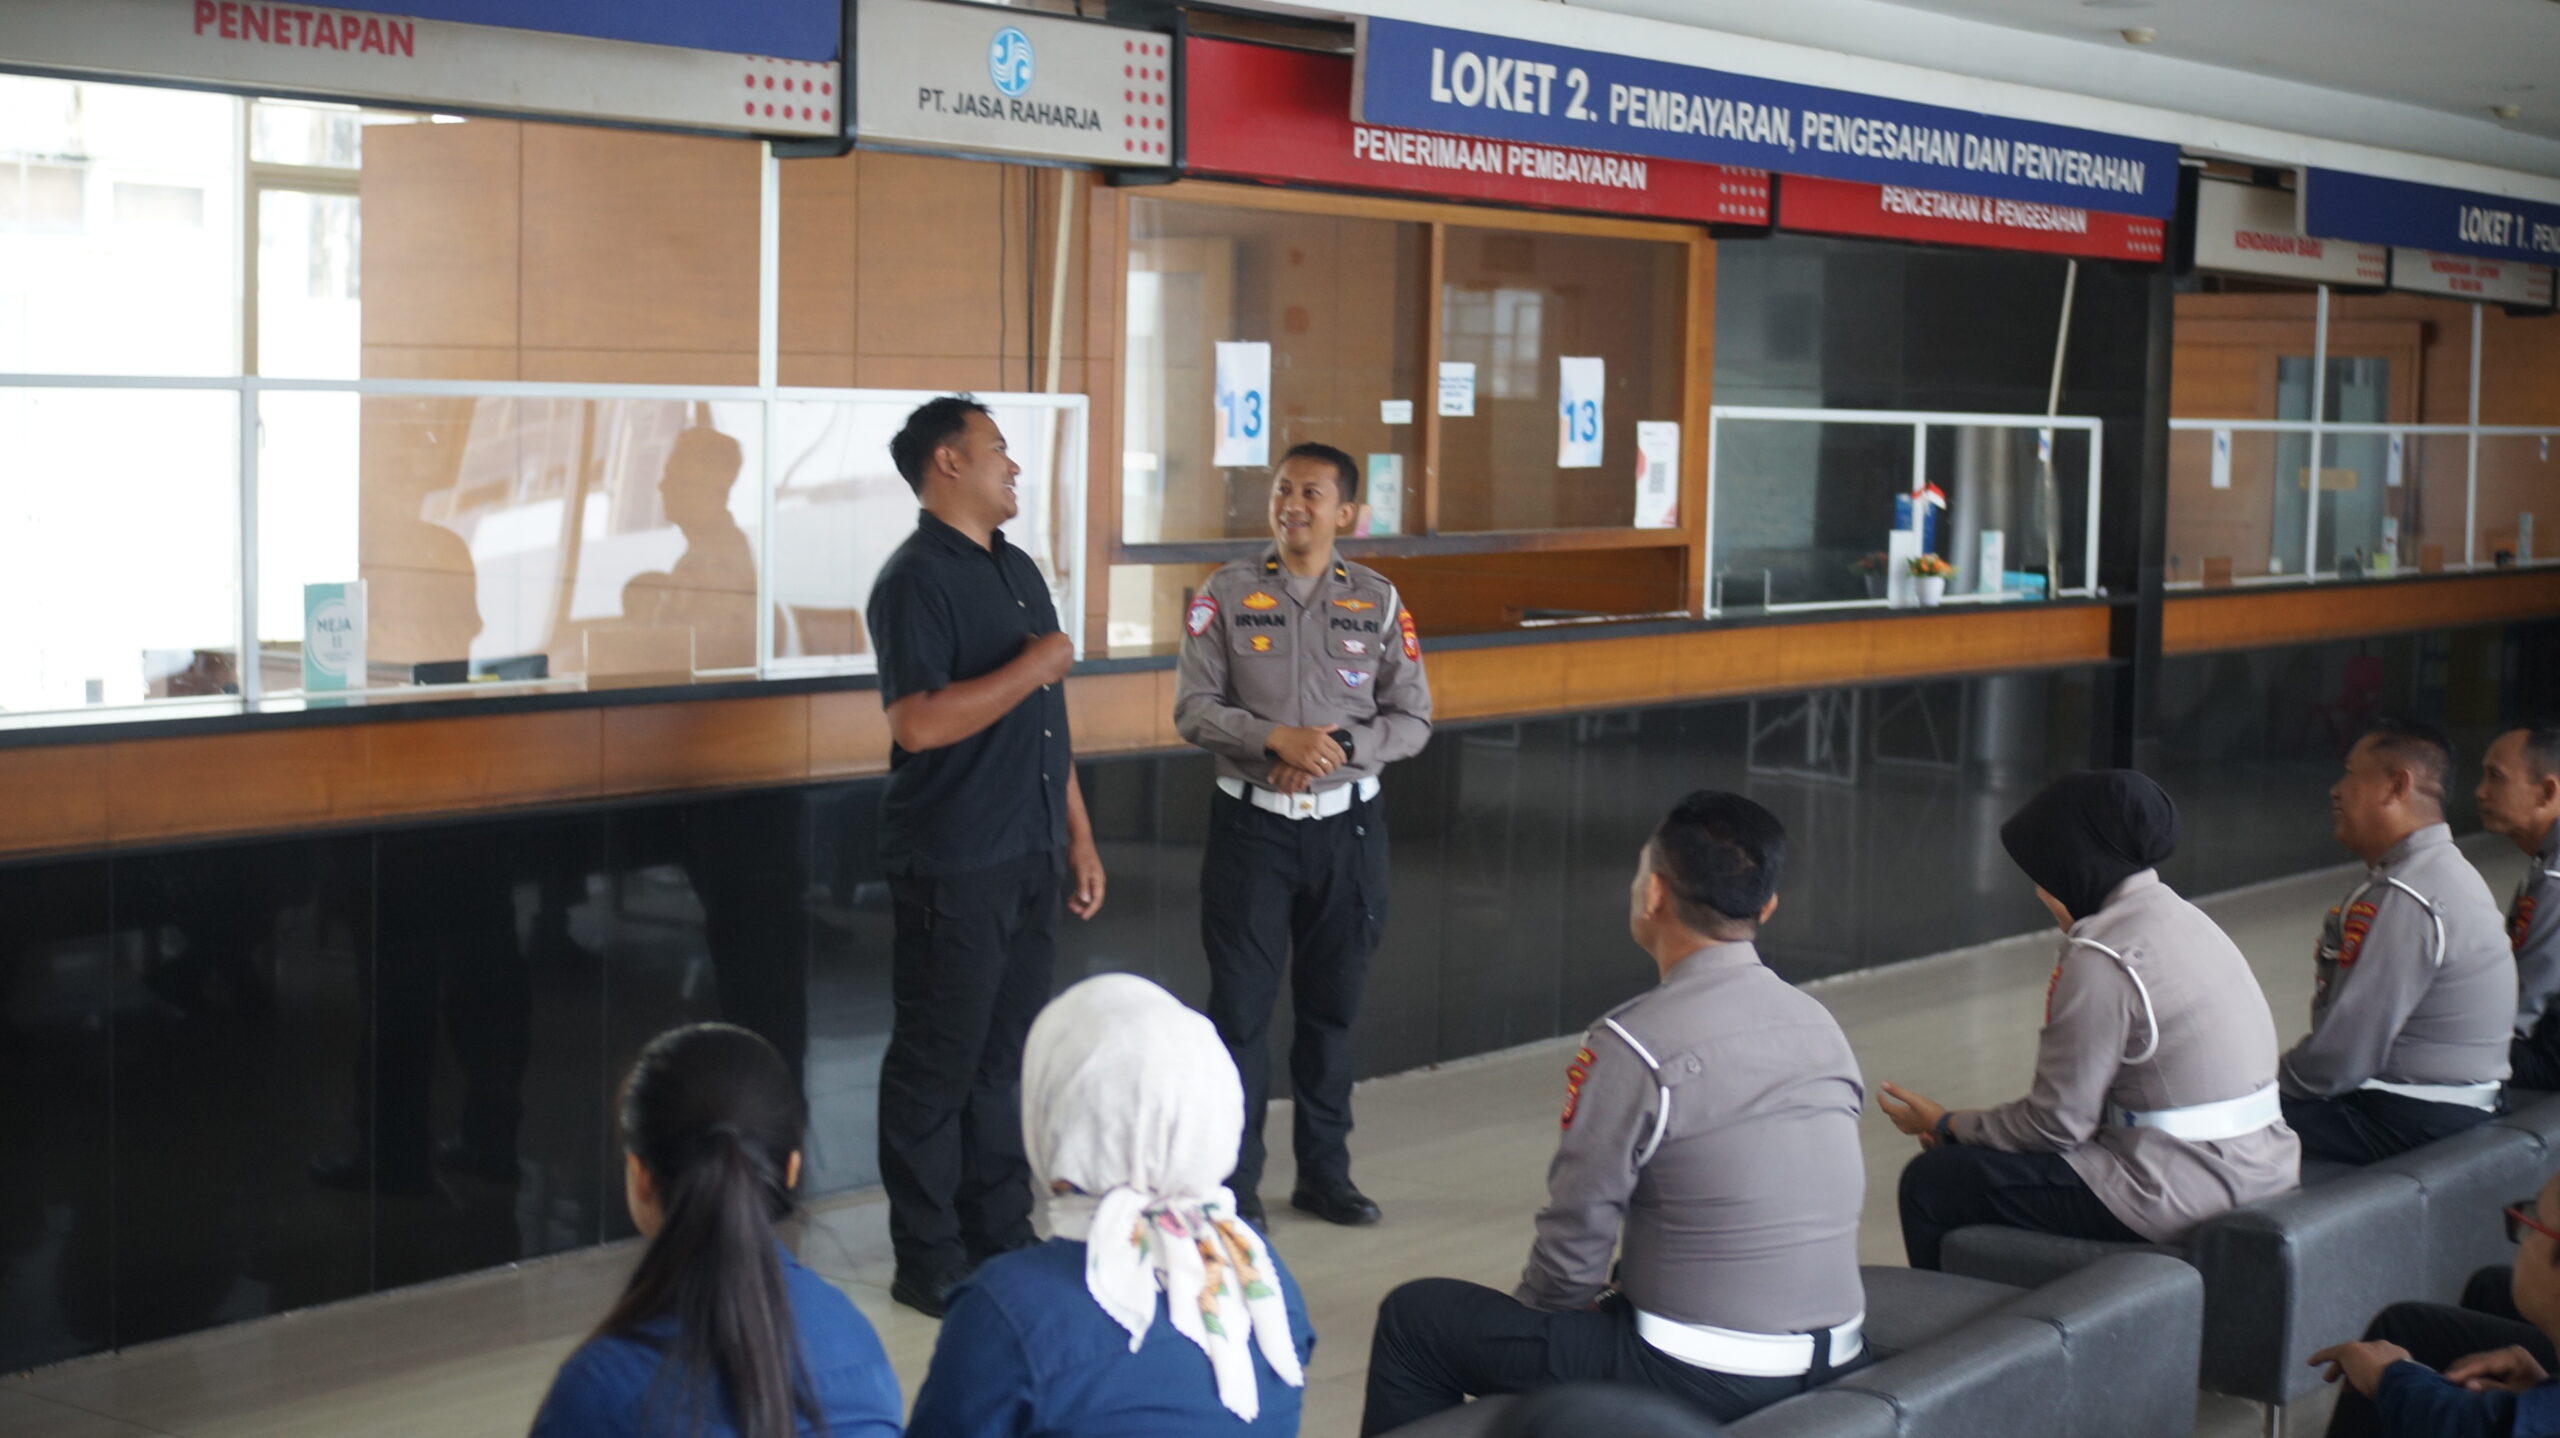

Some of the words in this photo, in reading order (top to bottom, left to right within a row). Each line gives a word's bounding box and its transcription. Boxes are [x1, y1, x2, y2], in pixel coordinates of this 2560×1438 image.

[194, 0, 415, 57] PENETAPAN
[918, 87, 947, 114] PT.
[953, 91, 1005, 121] JASA
[1010, 98, 1103, 131] RAHARJA
[1431, 48, 1557, 117] LOKET
[1565, 68, 1598, 122] 2.
[1609, 84, 1796, 154] PEMBAYARAN,
[1801, 110, 1961, 168] PENGESAHAN
[1963, 134, 2009, 175] DAN
[2012, 143, 2146, 195] PENYERAHAN
[1353, 127, 1502, 174] PENERIMAAN
[1507, 146, 1648, 191] PEMBAYARAN
[1881, 184, 1981, 224] PENCETAKAN
[1982, 200, 1994, 224] &
[1994, 199, 2087, 234] PENGESAHAN
[2459, 204, 2513, 247] LOKET
[1219, 389, 1263, 439] 13
[1564, 399, 1598, 443] 13
[1235, 614, 1286, 628] IRVAN
[1330, 617, 1379, 633] POLRI
